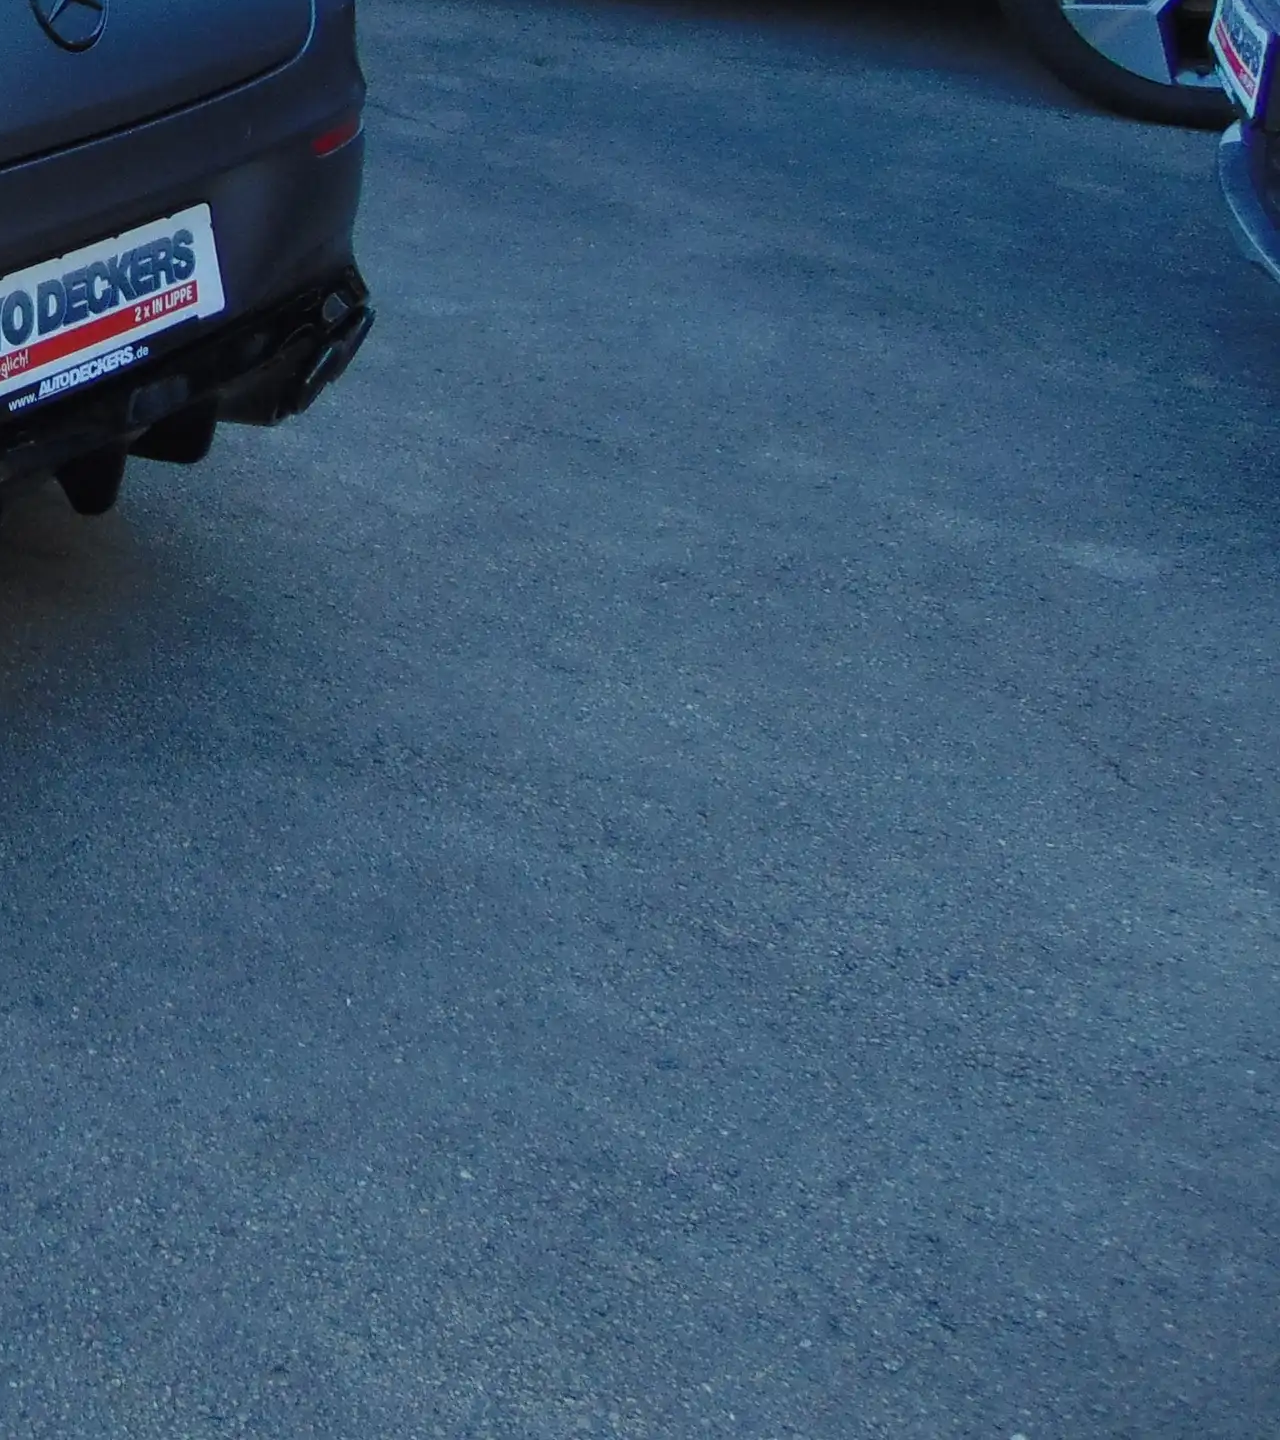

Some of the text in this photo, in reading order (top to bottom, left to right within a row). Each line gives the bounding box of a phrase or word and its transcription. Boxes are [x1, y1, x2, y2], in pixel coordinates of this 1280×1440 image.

[37, 228, 197, 337] DECKERS
[133, 285, 193, 323] 2 x IN LIPPE
[8, 344, 150, 412] www.AUTODECKERS.de
